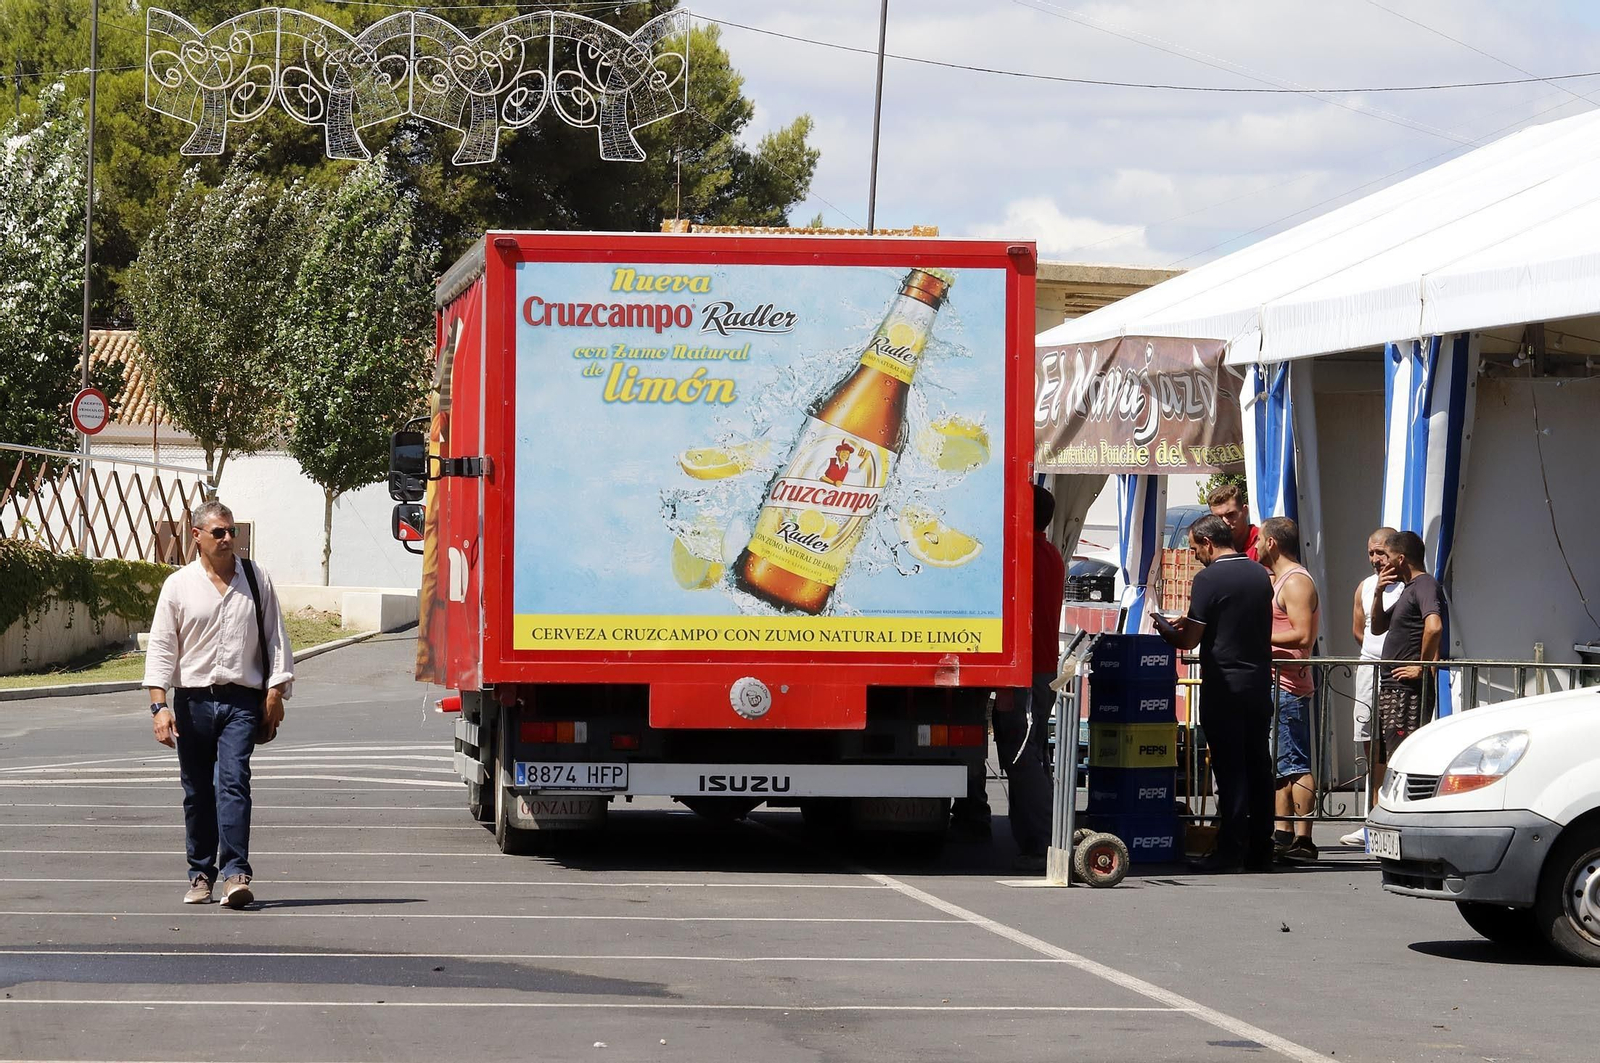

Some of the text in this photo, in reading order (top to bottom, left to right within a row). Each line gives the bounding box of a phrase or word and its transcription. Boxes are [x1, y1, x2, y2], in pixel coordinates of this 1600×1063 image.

[611, 268, 711, 293] Nueva
[523, 296, 798, 337] Cruzcampo Radler
[574, 343, 751, 361] con Zumo Natural
[869, 336, 918, 366] Radler
[582, 361, 738, 403] de limón
[1035, 350, 1066, 429] El
[1100, 439, 1149, 466] Ponche
[1155, 438, 1187, 465] del
[770, 480, 879, 513] Cruzcampo
[777, 521, 830, 555] Radler
[765, 537, 784, 551] ZUMO
[783, 545, 813, 564] NATURAL
[813, 558, 822, 567] DE
[531, 627, 982, 645] CERVEZA CRUZCAMPO CON ZUMO NATURAL DE LIMÓN
[1140, 654, 1169, 667] PEPSI
[1139, 698, 1169, 712] PEPSI
[1139, 745, 1167, 756] PEPSI
[527, 766, 577, 783] 8874
[587, 766, 624, 784] HFP
[699, 775, 790, 792] ISUZU
[1138, 787, 1167, 800] PEPSI
[1132, 836, 1174, 848] PEPSI
